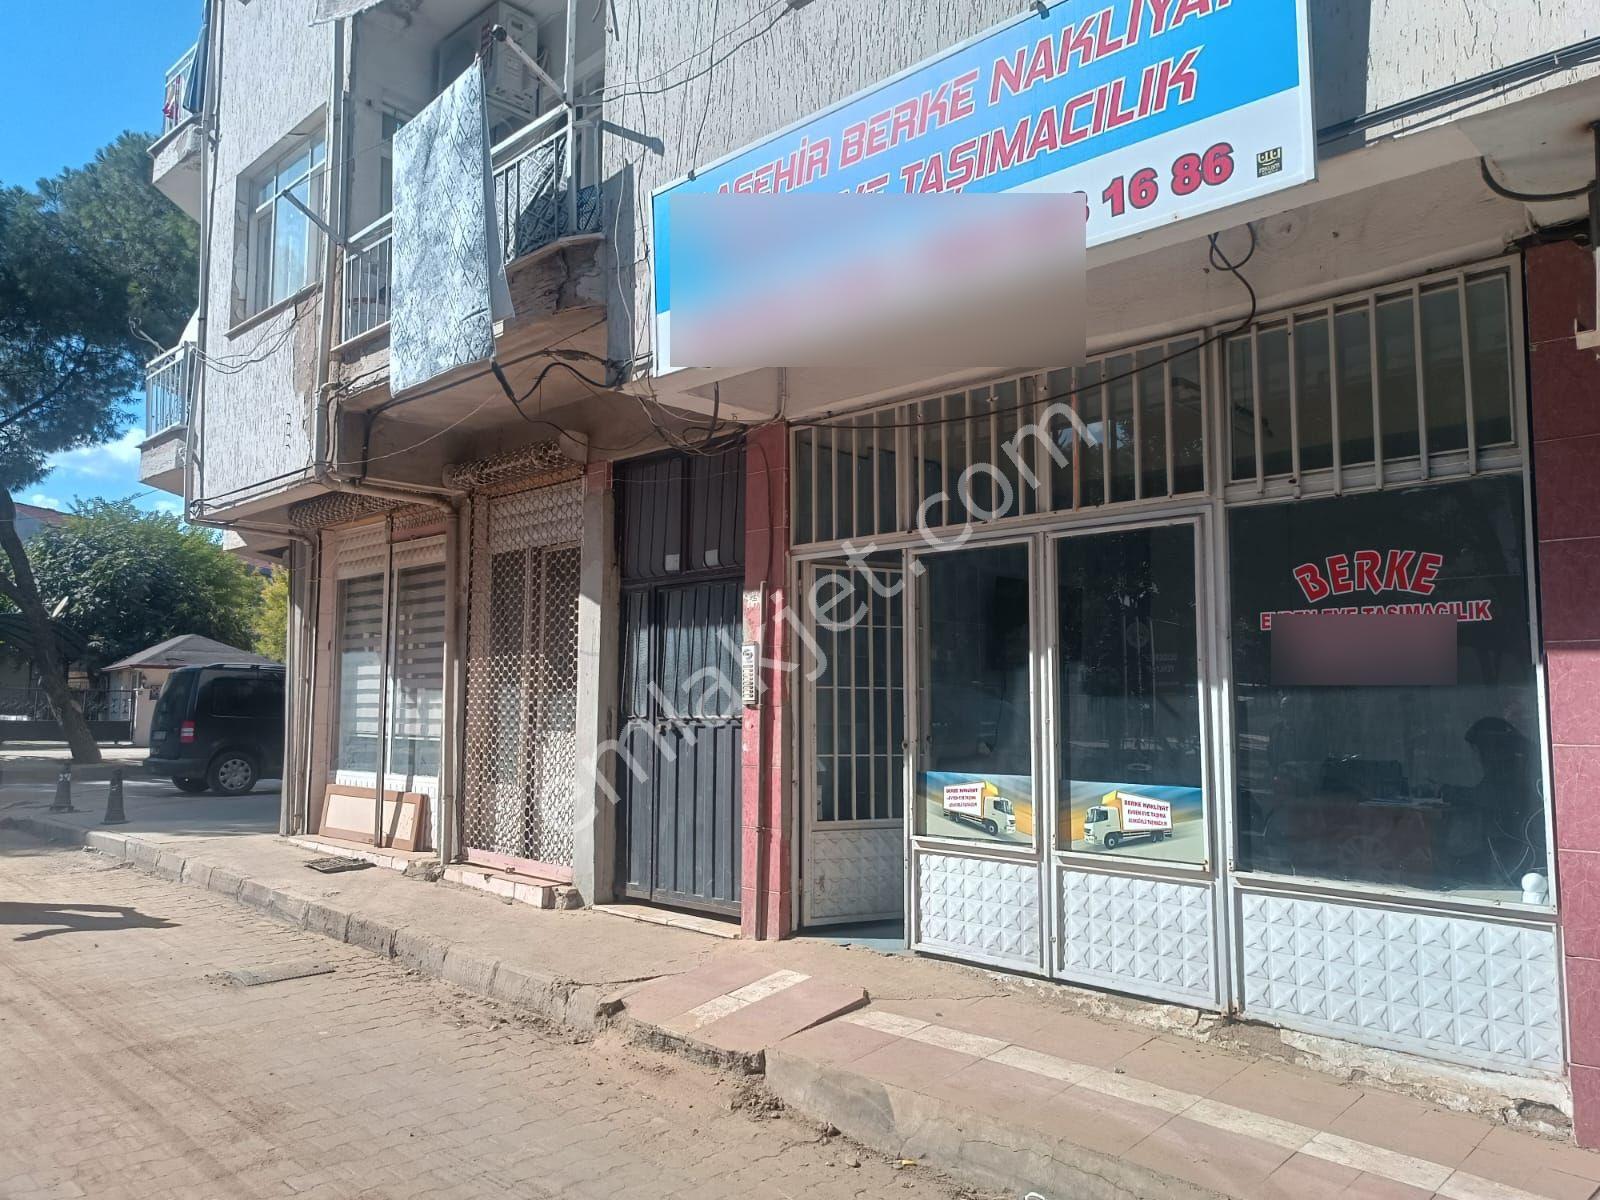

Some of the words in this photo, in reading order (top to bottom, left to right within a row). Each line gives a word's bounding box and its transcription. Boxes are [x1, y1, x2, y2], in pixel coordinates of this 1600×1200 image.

[839, 70, 979, 168] BERKE
[899, 44, 1204, 193] TAŞIMACILIK
[1103, 167, 1159, 217] 16
[1171, 142, 1234, 196] 86
[1293, 549, 1443, 603] BERKE
